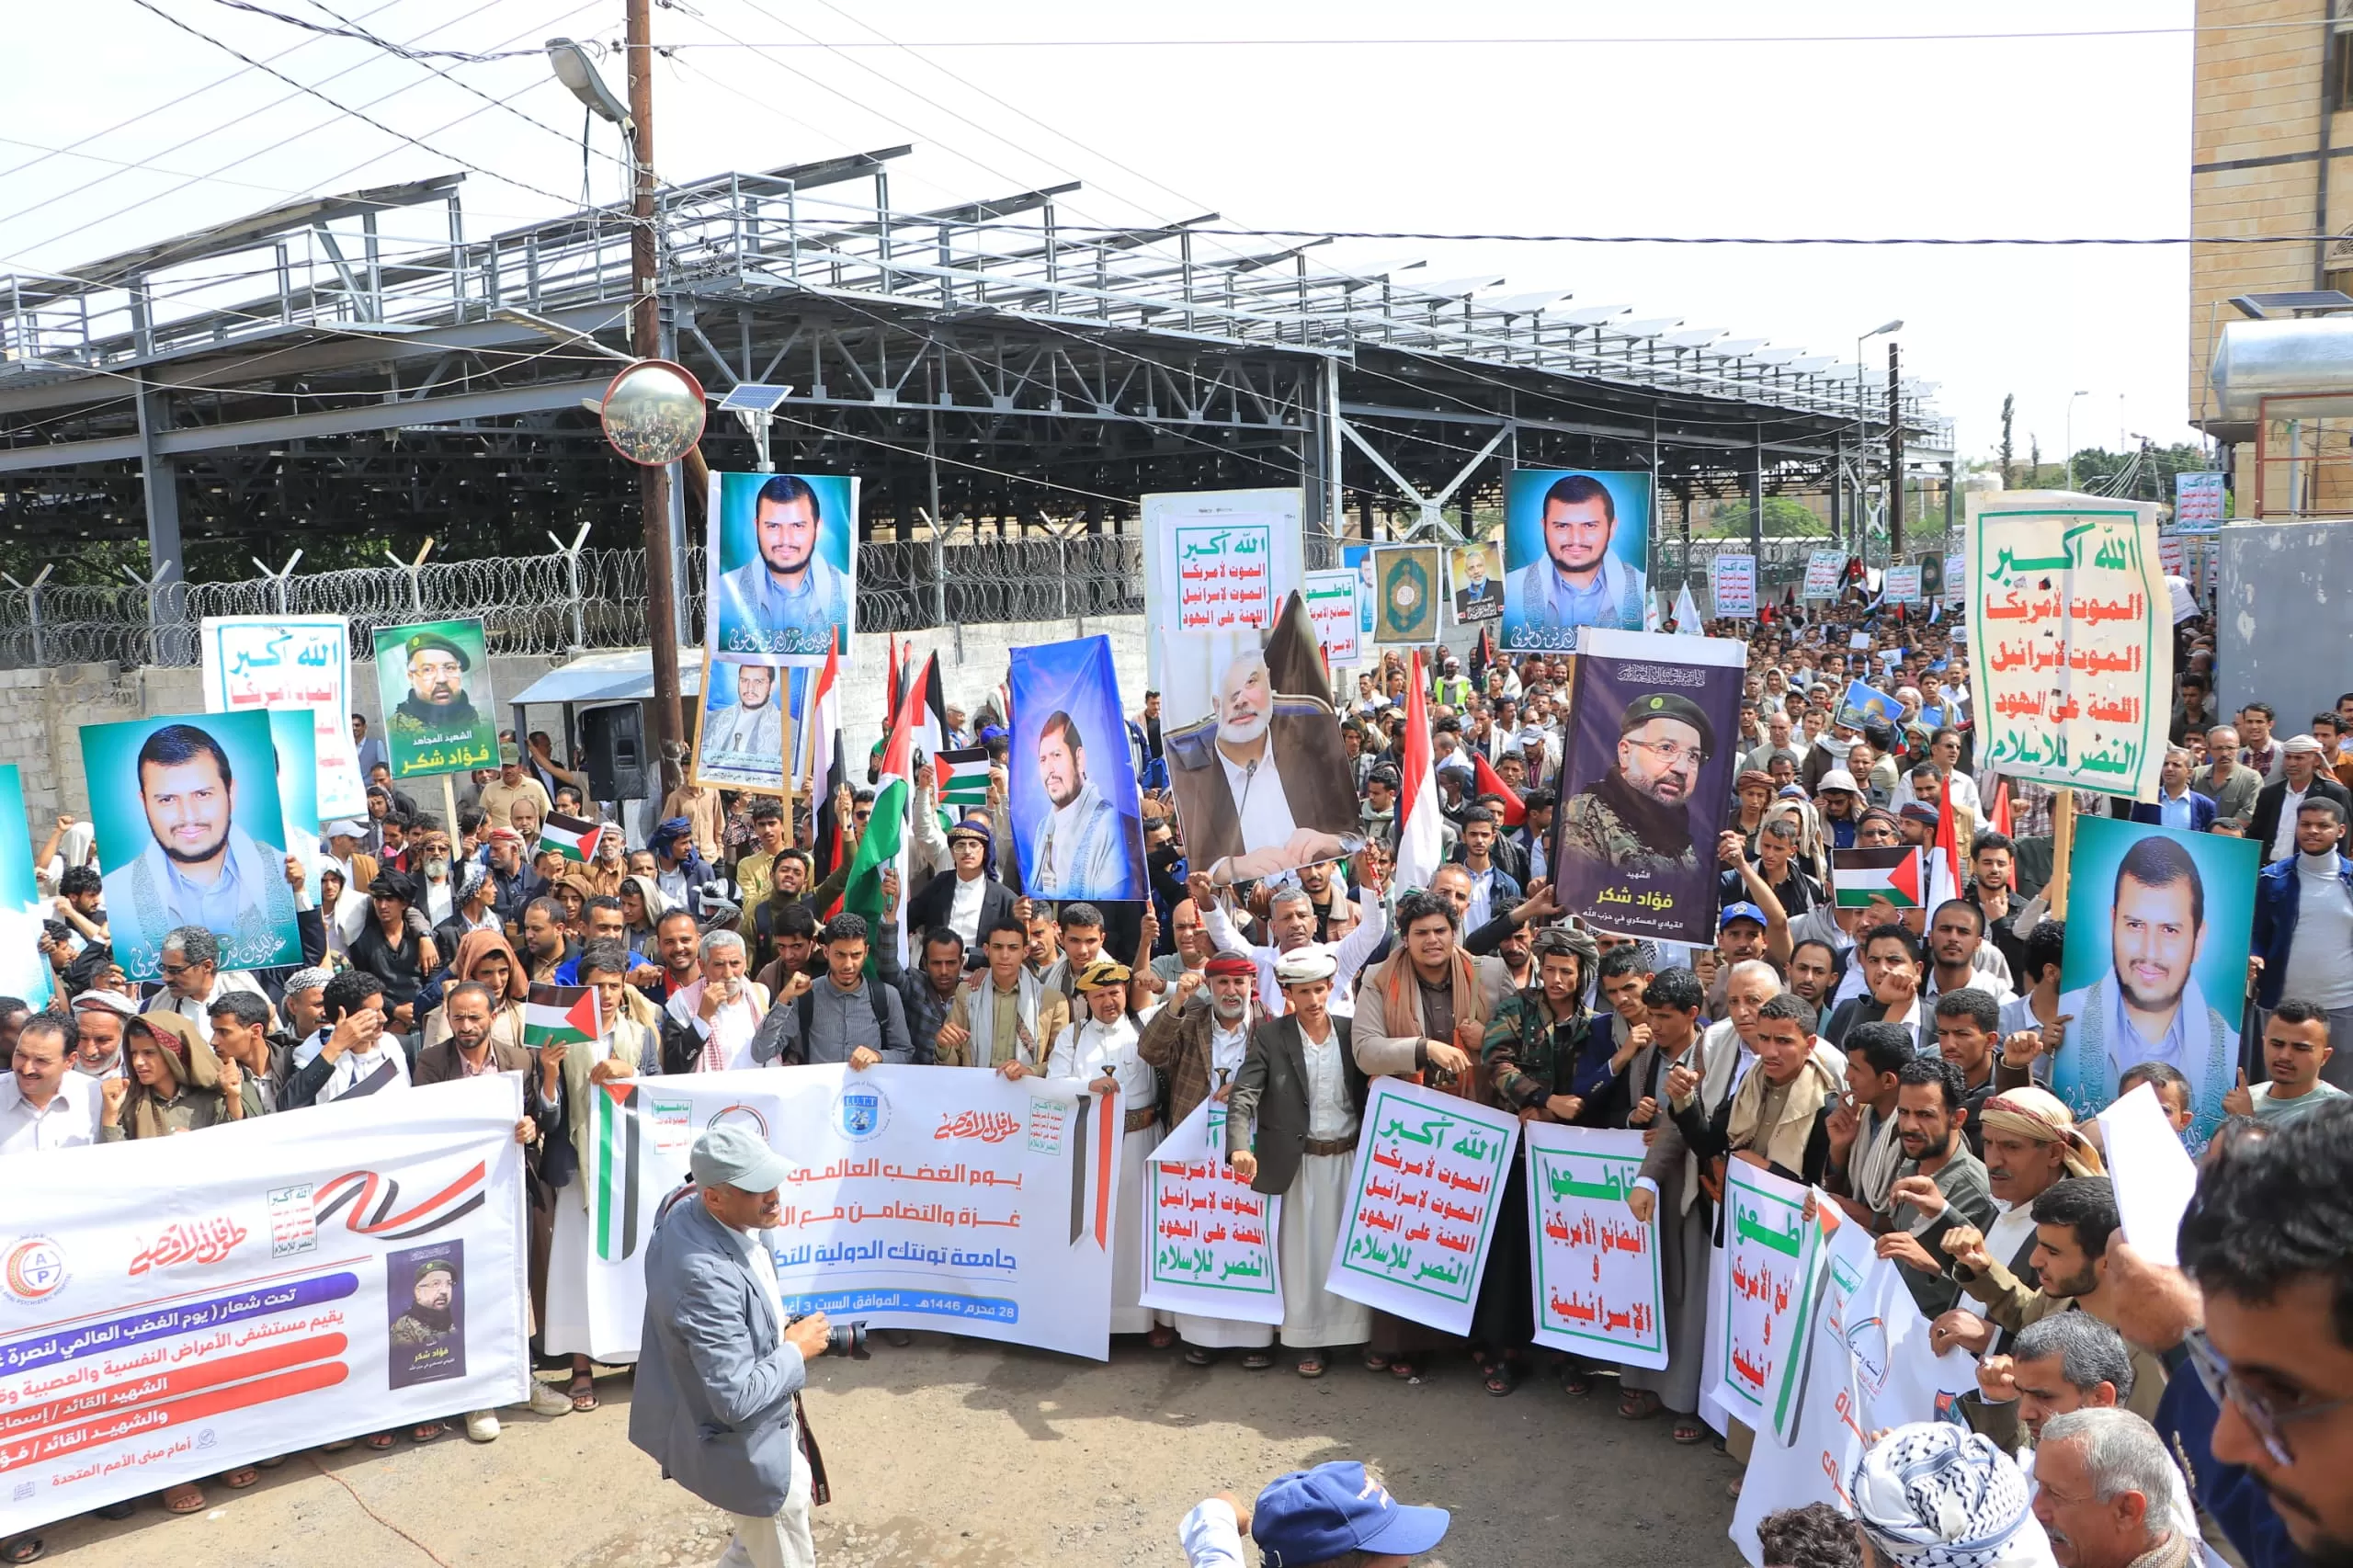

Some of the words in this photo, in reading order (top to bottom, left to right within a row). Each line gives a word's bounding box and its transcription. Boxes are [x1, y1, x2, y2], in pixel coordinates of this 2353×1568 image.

[1181, 529, 1232, 562] أكبر
[1233, 531, 1266, 553] الله
[1987, 517, 2096, 587] أكبر
[2094, 526, 2137, 572] الله
[1181, 561, 1226, 581] لأمريكا
[1230, 562, 1266, 580] الموت
[1182, 586, 1227, 605] لإسرائيل
[1230, 586, 1267, 603] الموت
[1985, 585, 2063, 623] لأمريكا
[1183, 609, 1213, 629] اليهود
[1218, 611, 1235, 627] على
[1239, 608, 1267, 629] اللعنة
[2069, 593, 2143, 626] الموت
[228, 629, 293, 678] أكبر
[298, 636, 338, 666] الله
[1991, 638, 2066, 674] لإسرائيل
[2068, 643, 2142, 676] الموت
[1995, 689, 2047, 722] اليهود
[2050, 693, 2079, 724] على
[2086, 693, 2140, 723] اللعنة
[413, 733, 443, 746] المجاهد
[445, 730, 472, 744] الشهيد
[402, 749, 445, 774] شكر
[449, 744, 490, 767] فؤاد
[1991, 729, 2067, 775] للإسلام
[2071, 737, 2138, 777] النصر
[1626, 870, 1651, 880] الشهيد
[1596, 886, 1631, 904] شكر
[1636, 891, 1674, 911] فؤاد
[1582, 906, 1597, 917] الله
[1597, 912, 1612, 921] حزب
[1614, 915, 1625, 925] في
[1626, 916, 1656, 926] العسكري
[1657, 920, 1684, 930] القيادي
[1379, 1116, 1455, 1149] أكبر
[1452, 1130, 1499, 1164] الله
[787, 1157, 880, 1185] العالمي
[883, 1162, 965, 1184] الغضب
[1373, 1143, 1435, 1178] لأمريكا
[970, 1170, 1023, 1191] يوم
[1438, 1167, 1490, 1195] الموت
[1543, 1157, 1635, 1203] قاطعوا
[1159, 1186, 1216, 1214] لإسرائيل
[1365, 1175, 1428, 1212] لإسرائيل
[799, 1204, 845, 1230] مع
[848, 1199, 954, 1229] والتضامن
[958, 1205, 1021, 1229] غزة
[1221, 1197, 1264, 1219] الموت
[1358, 1207, 1403, 1233] اليهود
[1431, 1197, 1483, 1224] الموت
[1159, 1218, 1199, 1241] اليهود
[1203, 1223, 1227, 1244] على
[1233, 1223, 1266, 1246] اللعنة
[1405, 1222, 1430, 1242] على
[1436, 1226, 1476, 1254] اللعنة
[1546, 1209, 1597, 1248] الأمريكية
[1601, 1218, 1646, 1259] البضائع
[36, 1254, 47, 1266] A
[815, 1239, 882, 1267] الدولية
[888, 1244, 948, 1267] تونتك
[950, 1246, 1017, 1274] جامعة
[1159, 1244, 1214, 1279] للإسلام
[1219, 1250, 1268, 1280] النصر
[1350, 1233, 1412, 1274] للإسلام
[37, 1270, 50, 1283] P
[1412, 1256, 1470, 1287] النصر
[1593, 1254, 1599, 1282] و
[221, 1298, 261, 1321] شعار
[265, 1288, 297, 1306] تحت
[804, 1302, 812, 1312] 3
[815, 1296, 850, 1312] السبت
[853, 1294, 901, 1309] الموافق
[964, 1303, 995, 1317] محرم
[182, 1310, 209, 1329] يوم
[310, 1310, 345, 1333] يقيم
[998, 1306, 1015, 1318] 28
[1551, 1286, 1652, 1338] الإسرائيلية
[124, 1312, 178, 1339] الغضب
[234, 1318, 306, 1347] مستشفى
[1764, 1313, 1772, 1346] و
[7, 1339, 57, 1367] لنصرة
[61, 1324, 120, 1359] العالمي
[171, 1331, 232, 1362] الأمراض
[103, 1347, 167, 1377] النفسية
[22, 1367, 100, 1396] والعصبية
[110, 1378, 168, 1405] الشهيد
[62, 1392, 107, 1416] القائد
[90, 1410, 169, 1441] والشهيد
[43, 1426, 88, 1452] القائد
[167, 1437, 192, 1458] أمام
[103, 1453, 136, 1476] الأمم
[138, 1447, 166, 1466] مبنى
[51, 1462, 101, 1487] المتحدة
